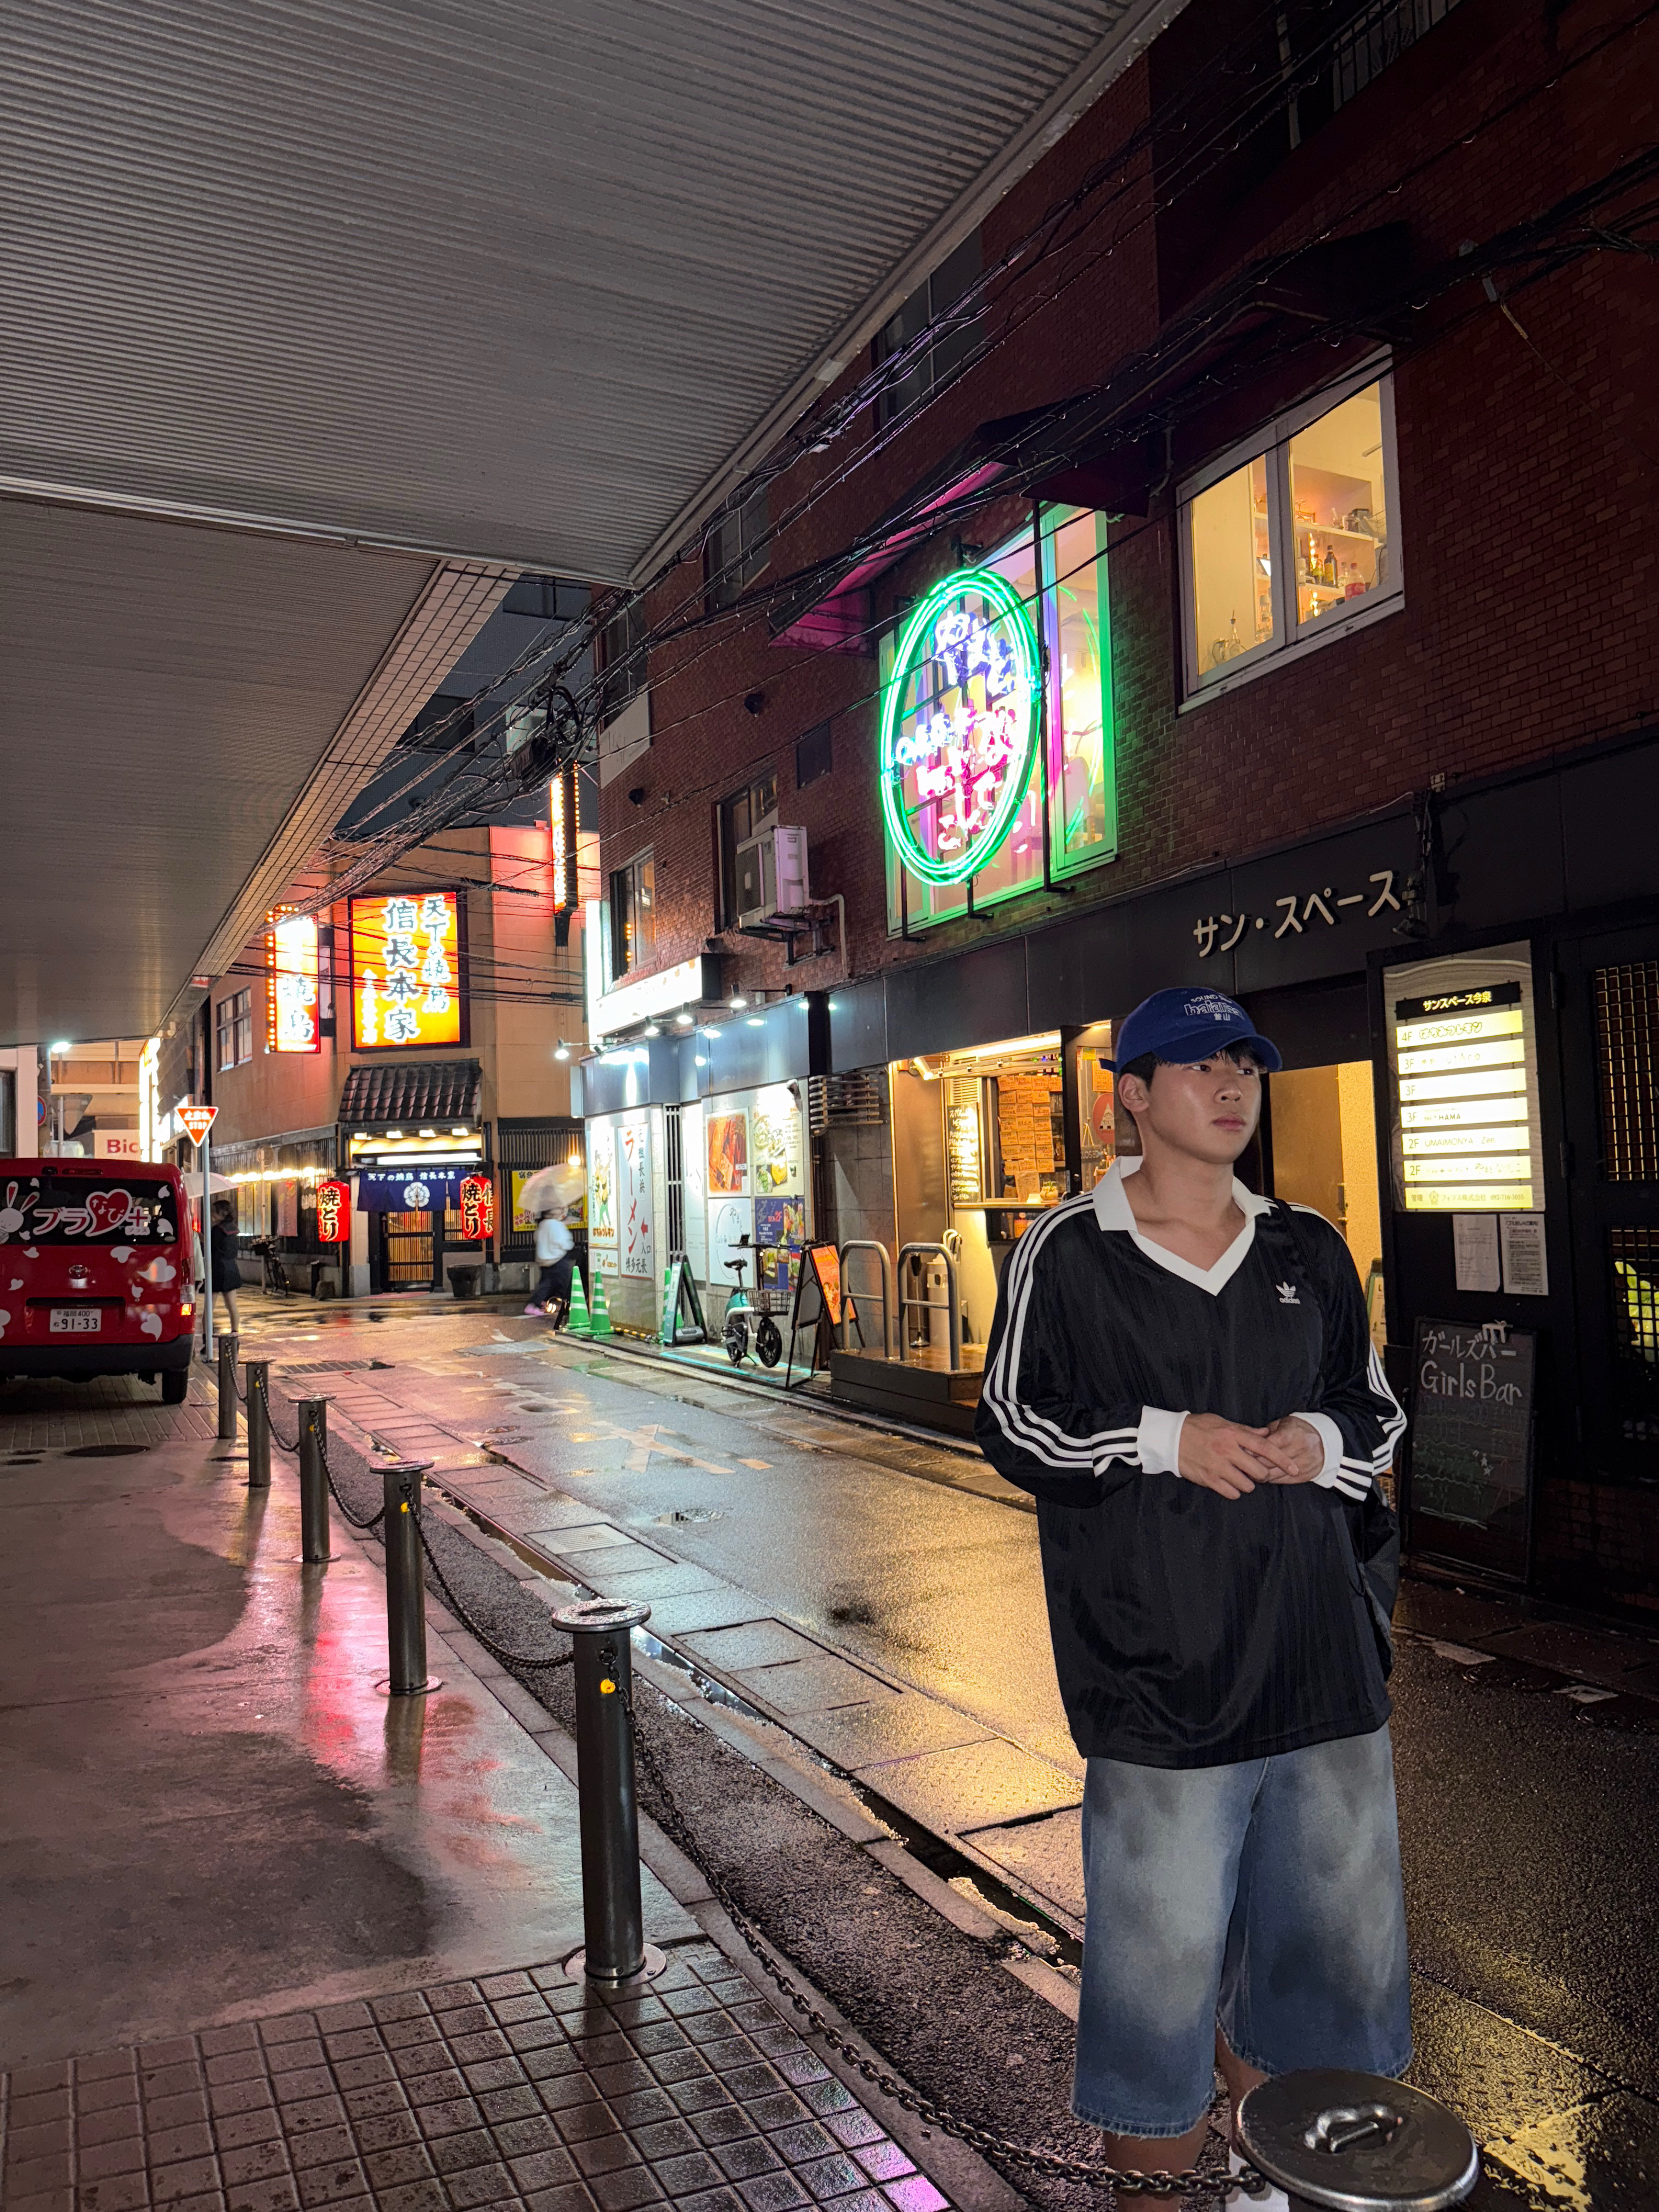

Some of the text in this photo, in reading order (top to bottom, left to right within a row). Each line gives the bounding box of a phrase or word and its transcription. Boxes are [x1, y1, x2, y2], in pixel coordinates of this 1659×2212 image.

[1193, 870, 1401, 957] サン・スペース
[384, 899, 420, 1041] 信長本家
[1190, 994, 1218, 1003] SOUND
[1423, 991, 1492, 1011] サンスペース今泉
[1402, 1022, 1482, 1041] 4F はちみつレモン
[1405, 1059, 1414, 1069] 3F
[1406, 1085, 1416, 1096] 3F
[1407, 1113, 1417, 1122] 3F
[1409, 1139, 1419, 1149] 2F
[419, 1171, 455, 1180] 信長本家
[1410, 1166, 1421, 1176] 2F
[625, 1130, 637, 1254] ラーメン
[92, 1199, 124, 1223] なび
[319, 1186, 341, 1241] 焼とり
[462, 1181, 483, 1239] 焼とり
[641, 1242, 651, 1255] 入口
[61, 1318, 98, 1330] 91-33
[1420, 1360, 1522, 1406] Girls Bar
